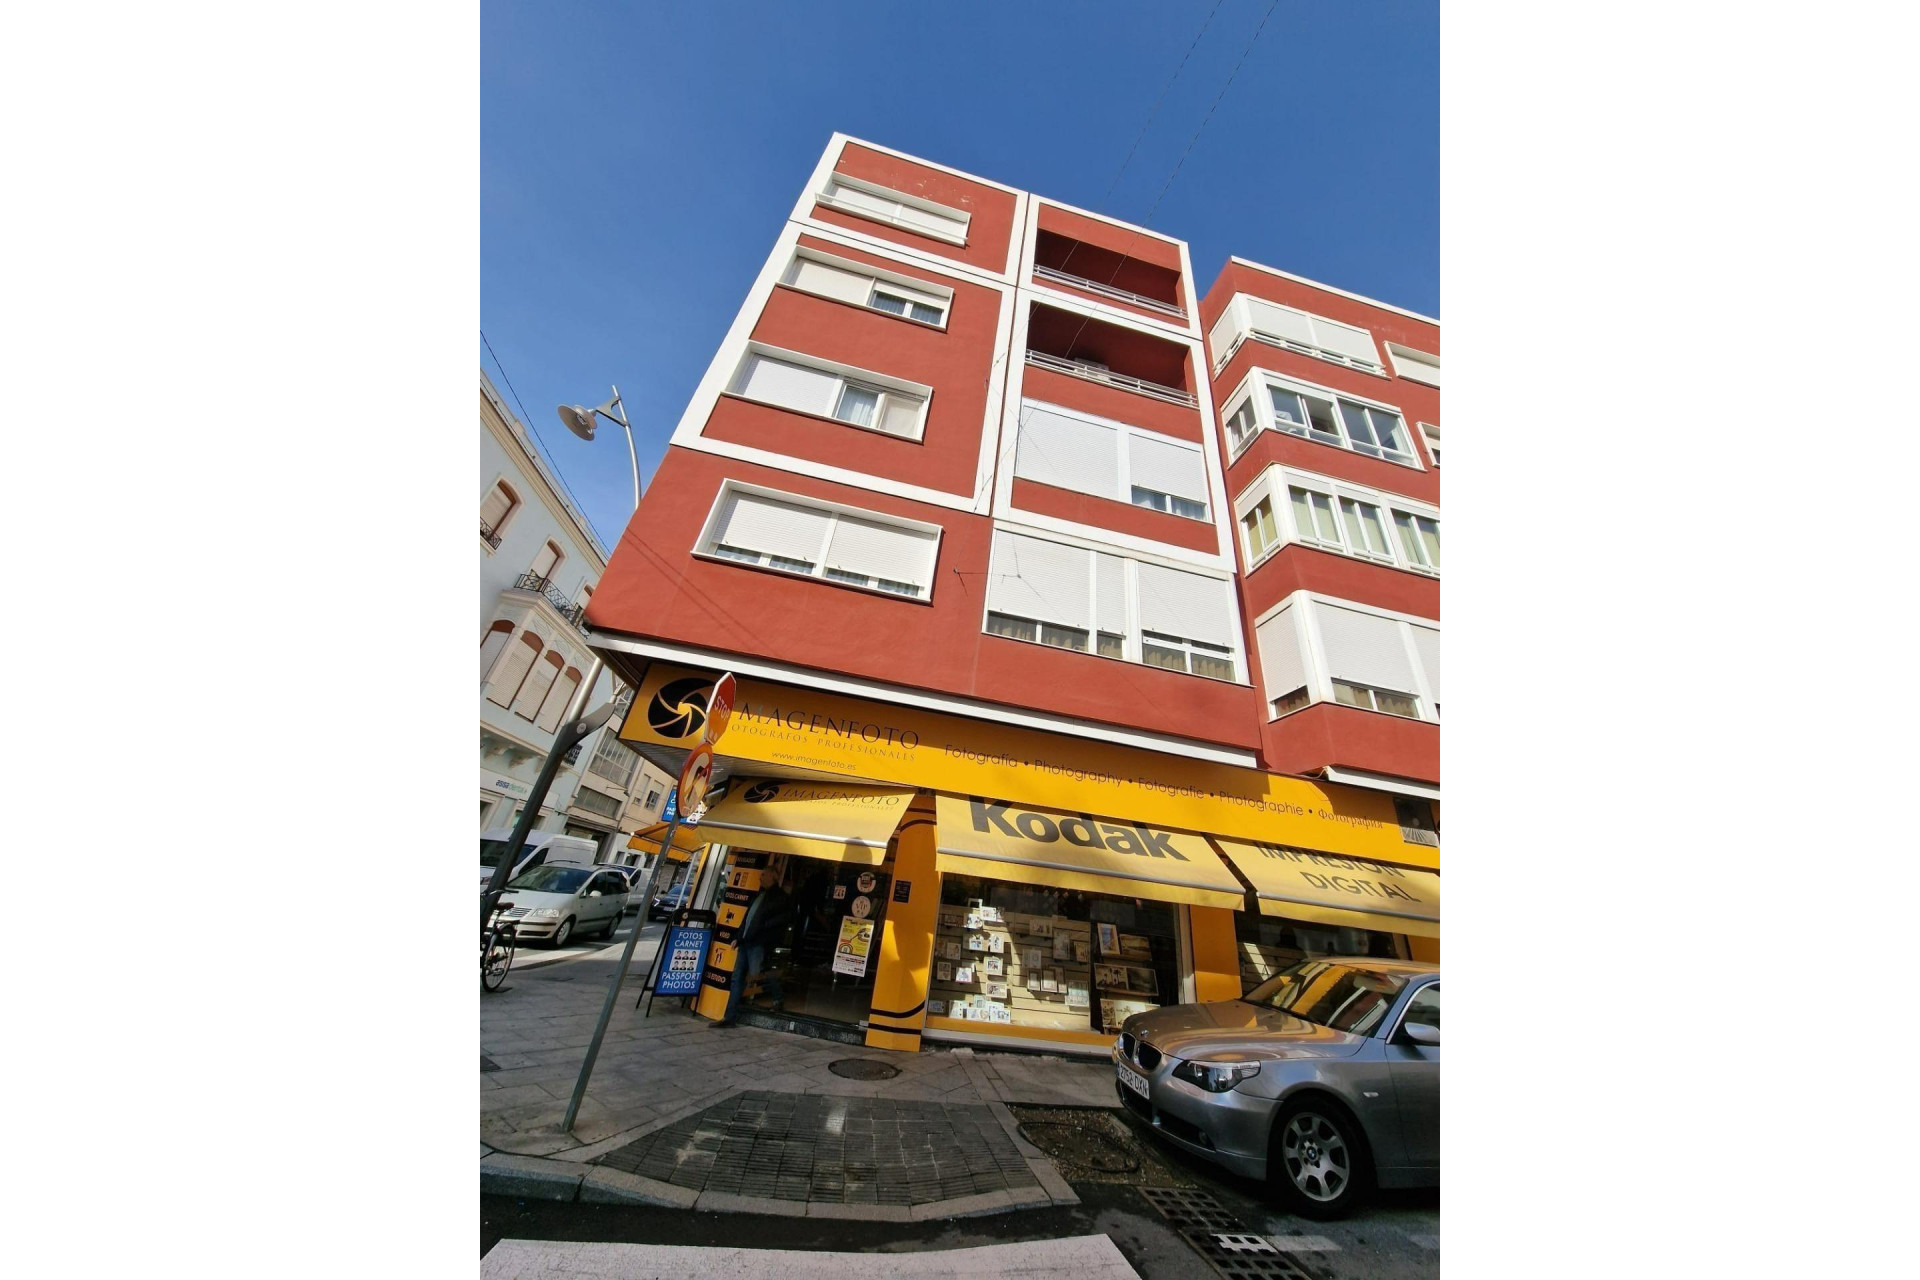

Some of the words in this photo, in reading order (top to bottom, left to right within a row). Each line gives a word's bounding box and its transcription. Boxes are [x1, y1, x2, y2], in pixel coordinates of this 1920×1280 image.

[714, 696, 731, 721] STOP
[738, 702, 919, 750] MAGENFOTO
[731, 723, 808, 744] OTOGRAFOS
[817, 738, 916, 762] PROFESIONALES
[771, 751, 857, 771] www.imagenfoto.es
[944, 744, 1018, 768] Fotografía
[1033, 759, 1123, 787] Photography
[1137, 777, 1205, 800] Fotografie
[1219, 790, 1304, 817] Photographie
[783, 787, 900, 807] IMAGENFOTO
[968, 795, 1191, 862] Kodak
[1317, 807, 1384, 831] Фотография
[1299, 871, 1422, 903] DIGITAL
[674, 940, 704, 948] CARNET
[678, 931, 703, 940] FOTOS
[661, 972, 701, 981] PASSPORT
[662, 980, 696, 989] PHOTOS
